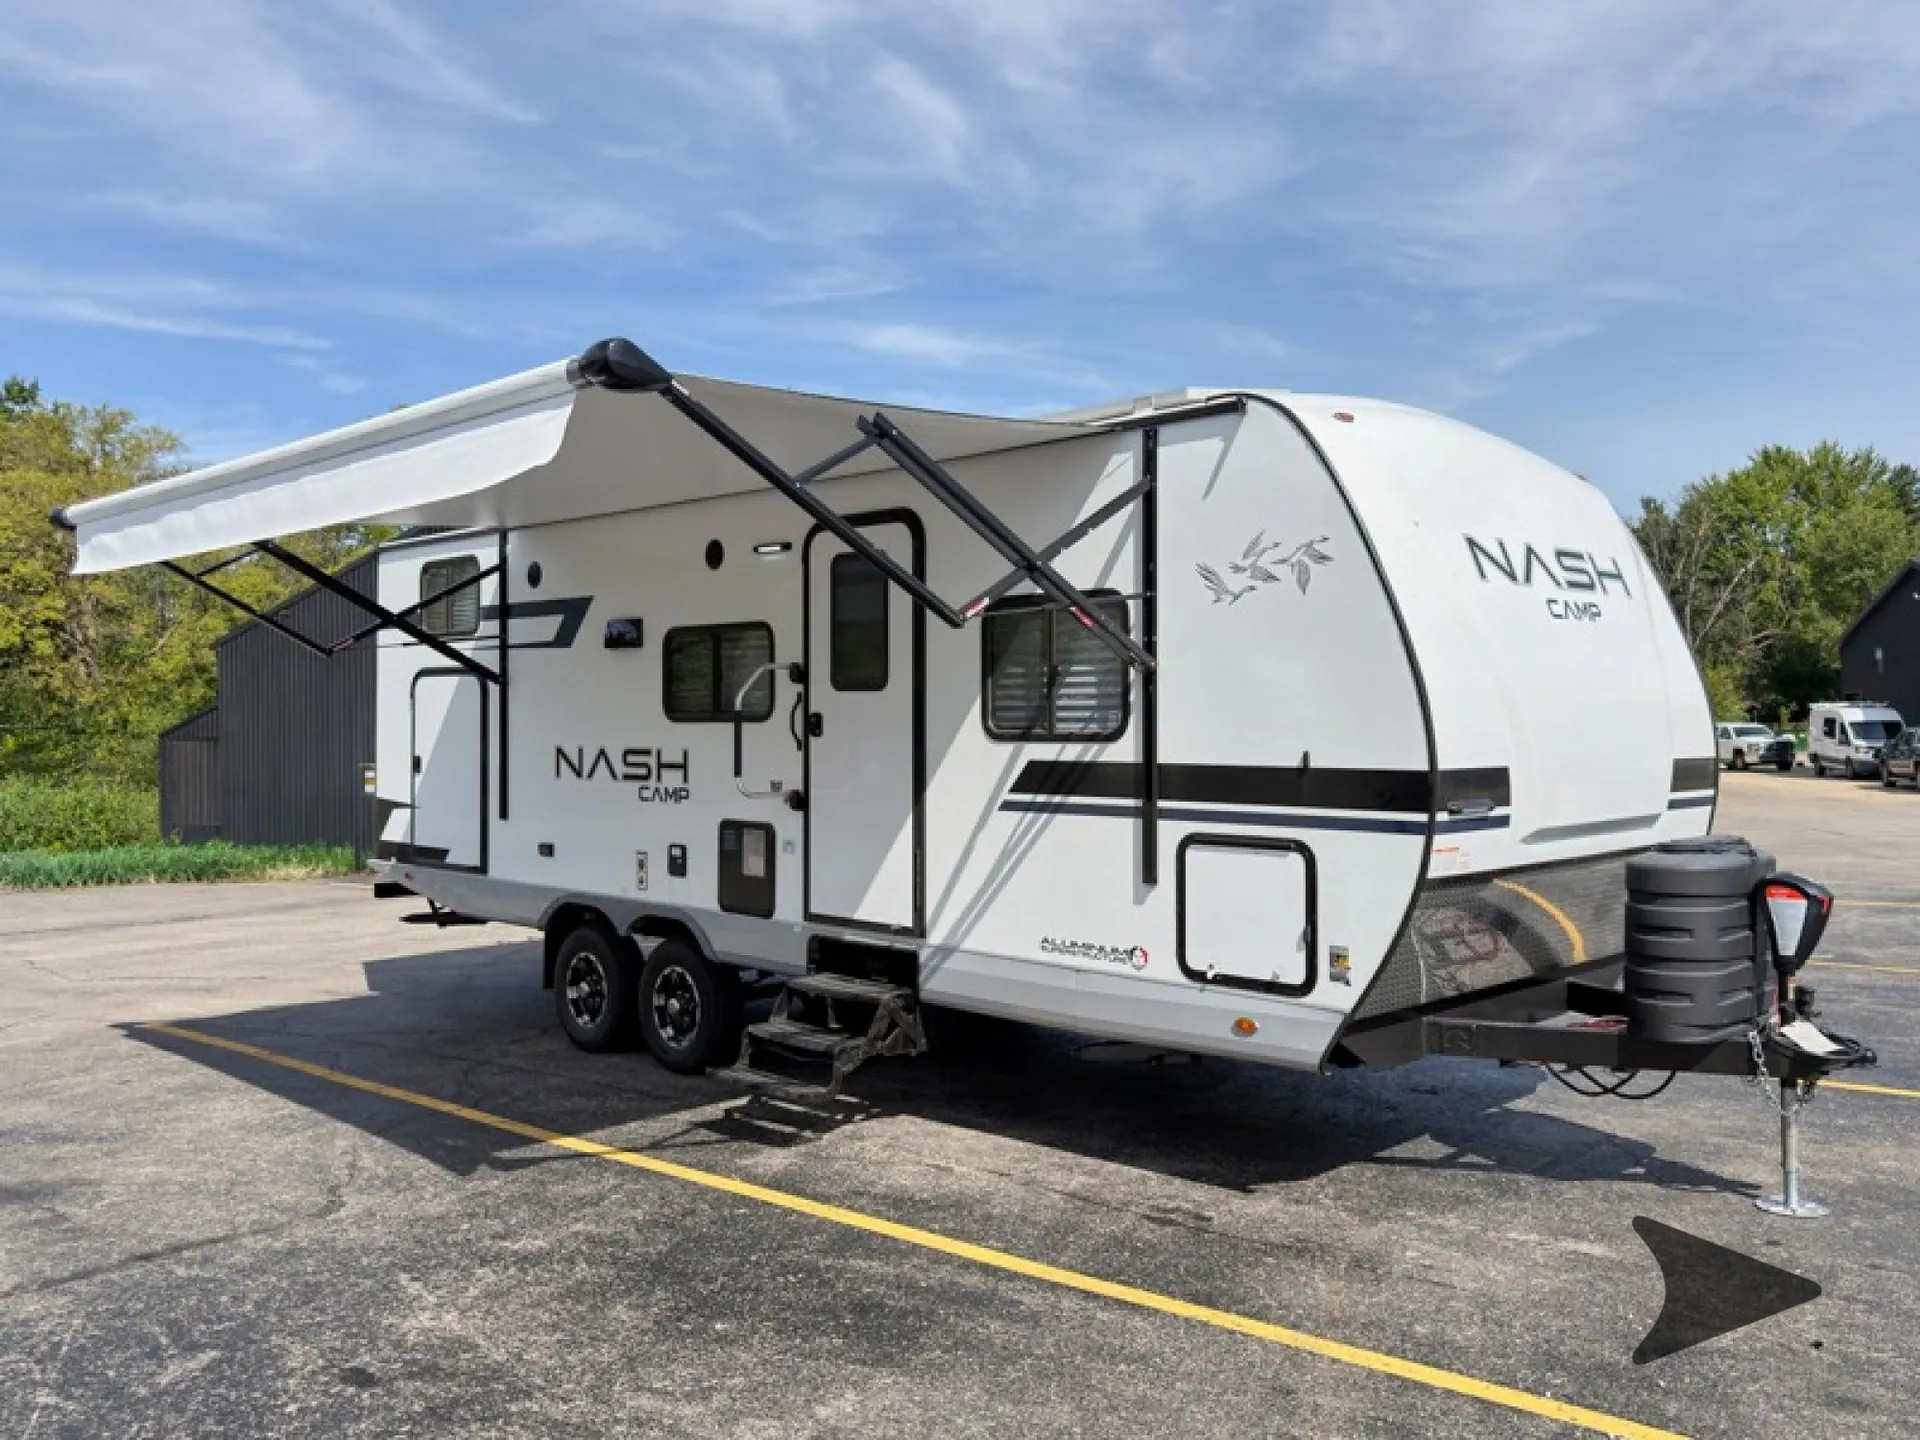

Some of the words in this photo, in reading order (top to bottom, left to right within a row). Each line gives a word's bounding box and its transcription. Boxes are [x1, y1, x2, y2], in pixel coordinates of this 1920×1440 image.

[1462, 532, 1633, 600] NASH
[1545, 597, 1603, 622] CAMP
[555, 744, 690, 784] NASH
[638, 784, 691, 804] CAMP
